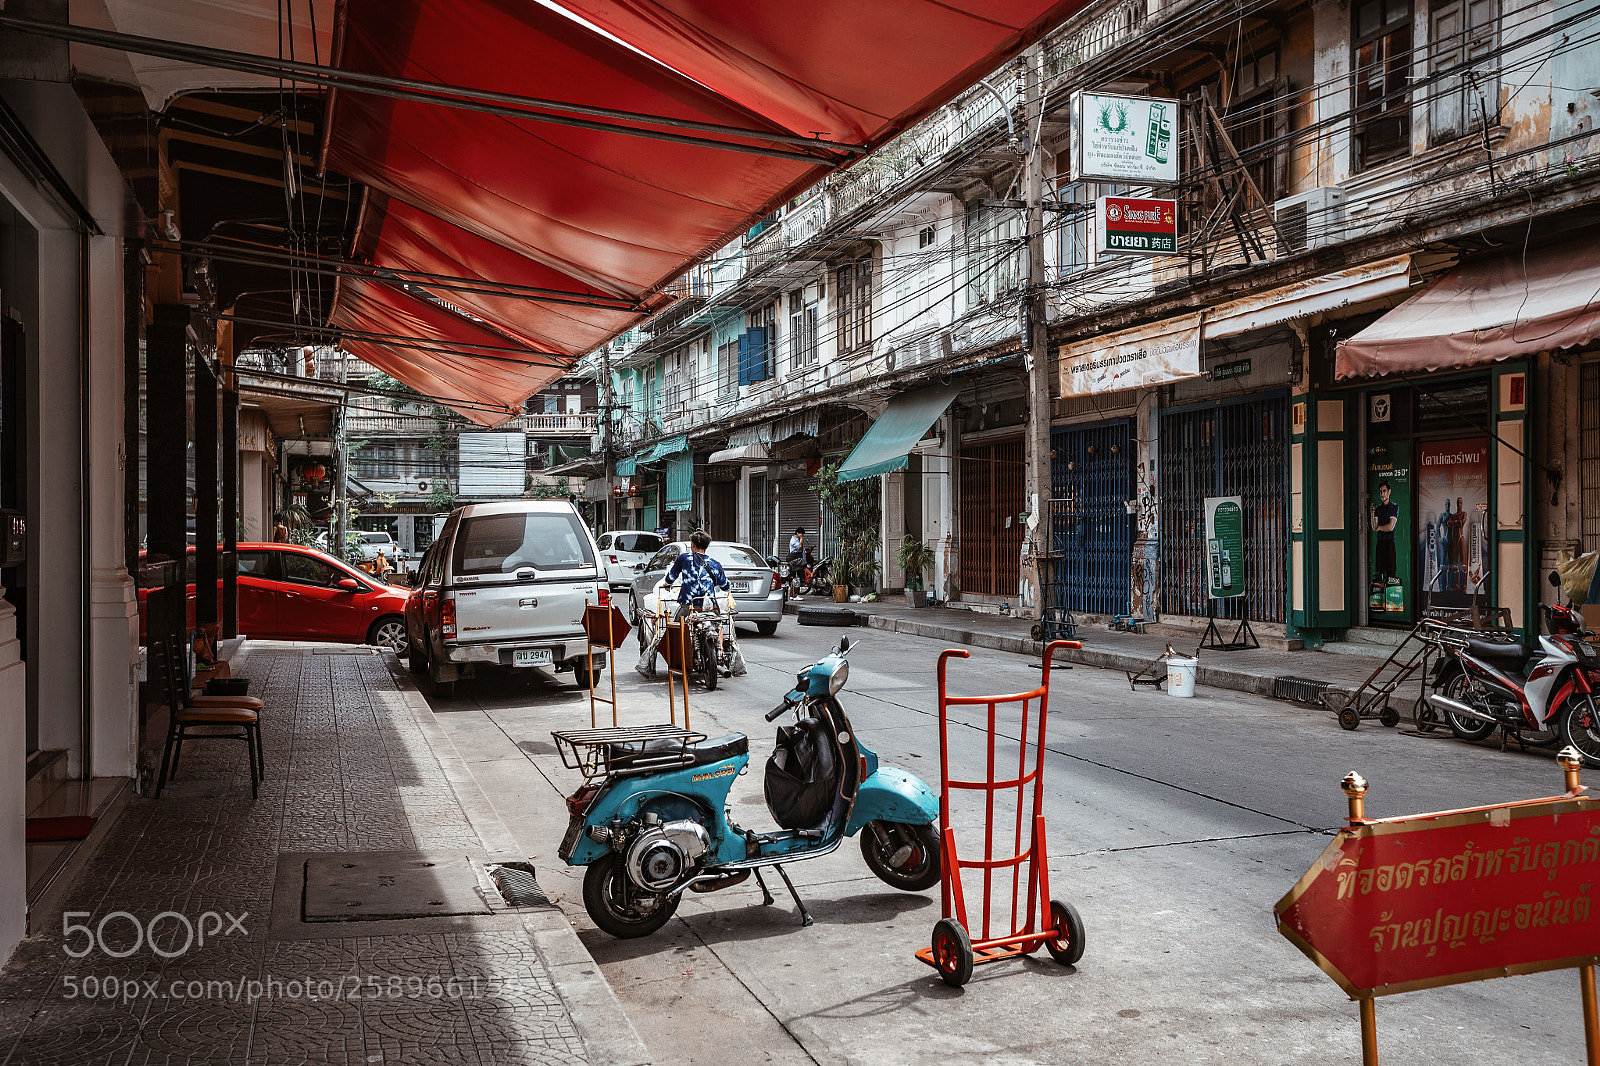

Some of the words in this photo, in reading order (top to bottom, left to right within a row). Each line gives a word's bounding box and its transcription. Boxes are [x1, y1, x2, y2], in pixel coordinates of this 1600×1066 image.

[1110, 235, 1148, 248] ขายยา
[1151, 236, 1172, 249] 药店
[530, 650, 549, 660] 2947
[692, 767, 736, 783] MALOSSI
